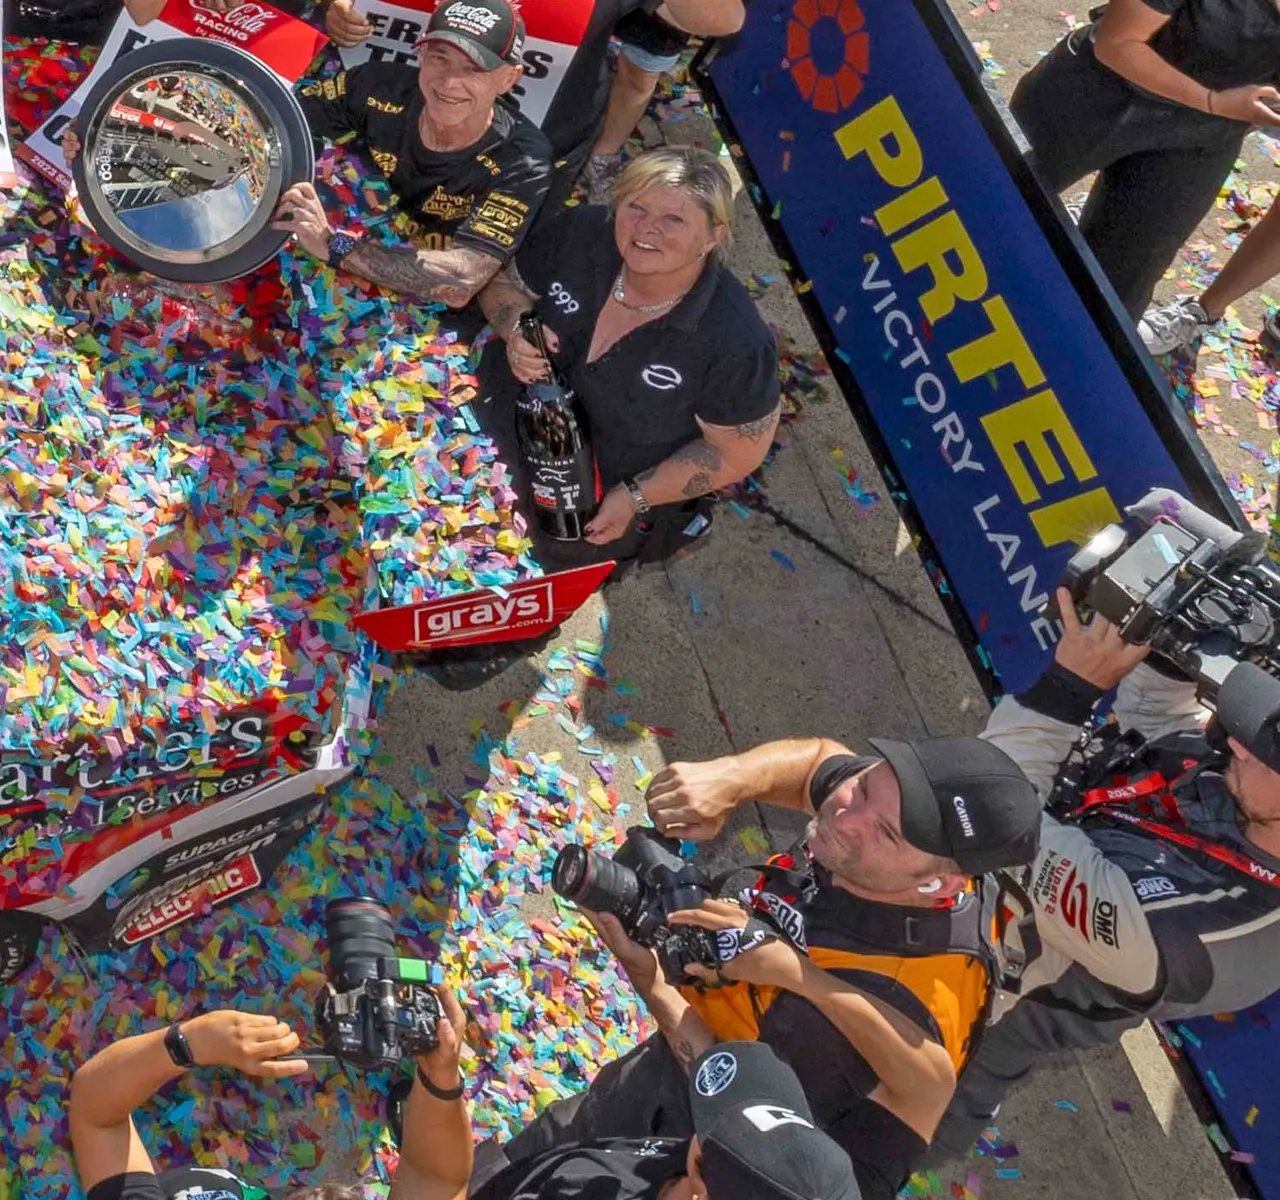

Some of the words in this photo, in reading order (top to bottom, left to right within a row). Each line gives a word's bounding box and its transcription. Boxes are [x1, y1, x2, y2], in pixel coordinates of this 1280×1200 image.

[193, 12, 249, 42] RACING
[445, 1, 502, 29] Coca-Cola
[549, 282, 580, 314] 999
[860, 254, 986, 480] VICTORY
[427, 594, 540, 636] grays
[512, 617, 544, 629] .com
[953, 796, 973, 837] Canon
[1097, 900, 1115, 947] OMP
